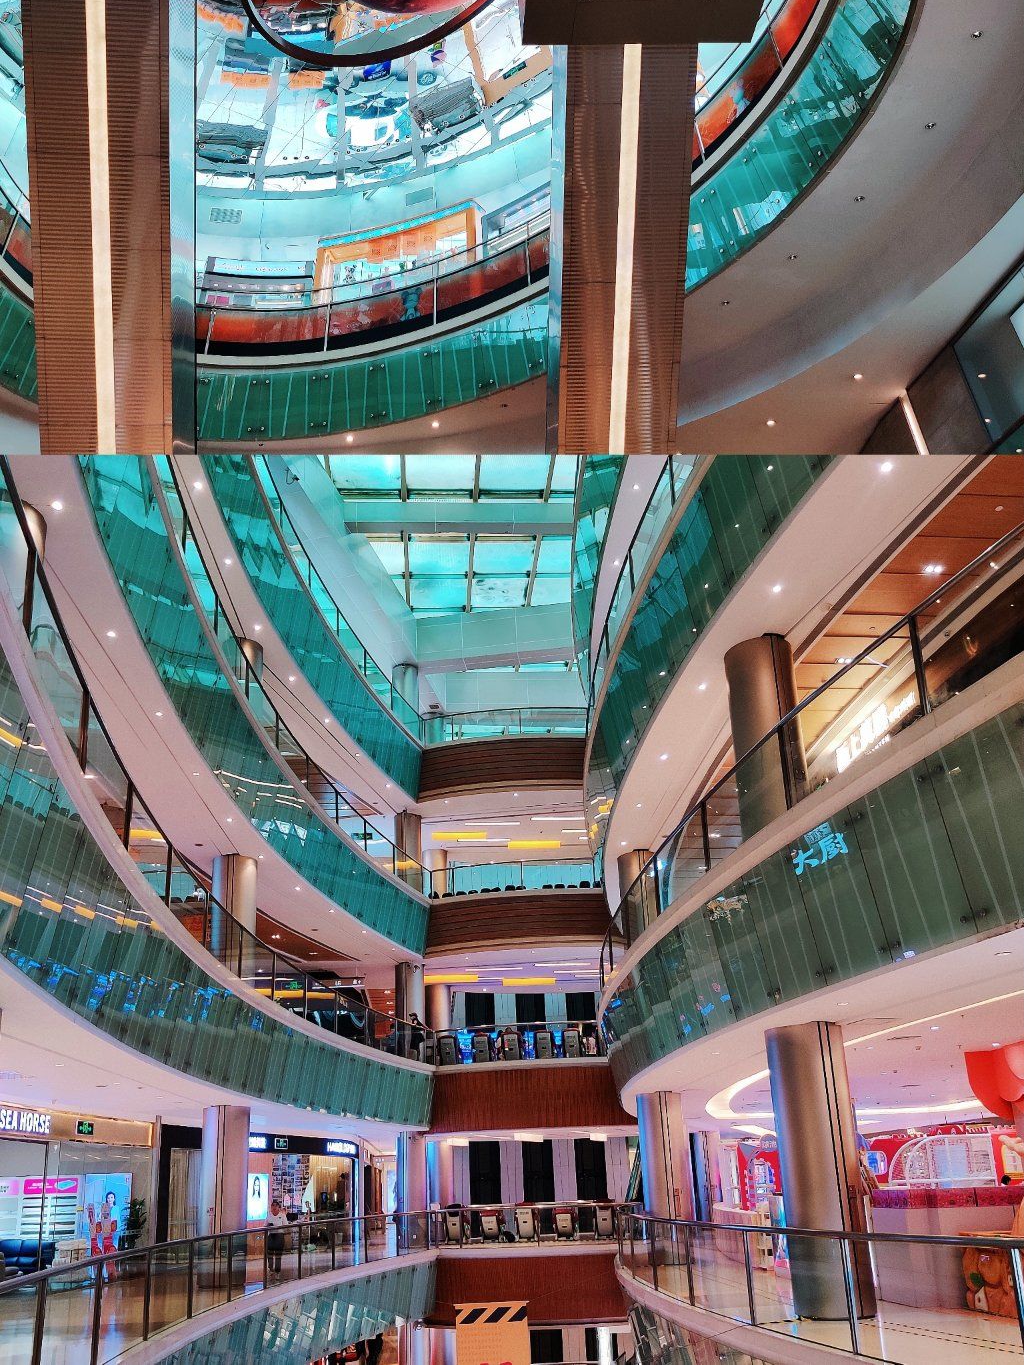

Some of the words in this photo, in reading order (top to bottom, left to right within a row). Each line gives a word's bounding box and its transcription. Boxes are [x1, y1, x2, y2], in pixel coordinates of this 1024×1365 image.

[793, 832, 848, 875] 大厨
[0, 1108, 18, 1131] SEA
[20, 1112, 51, 1134] HORSE
